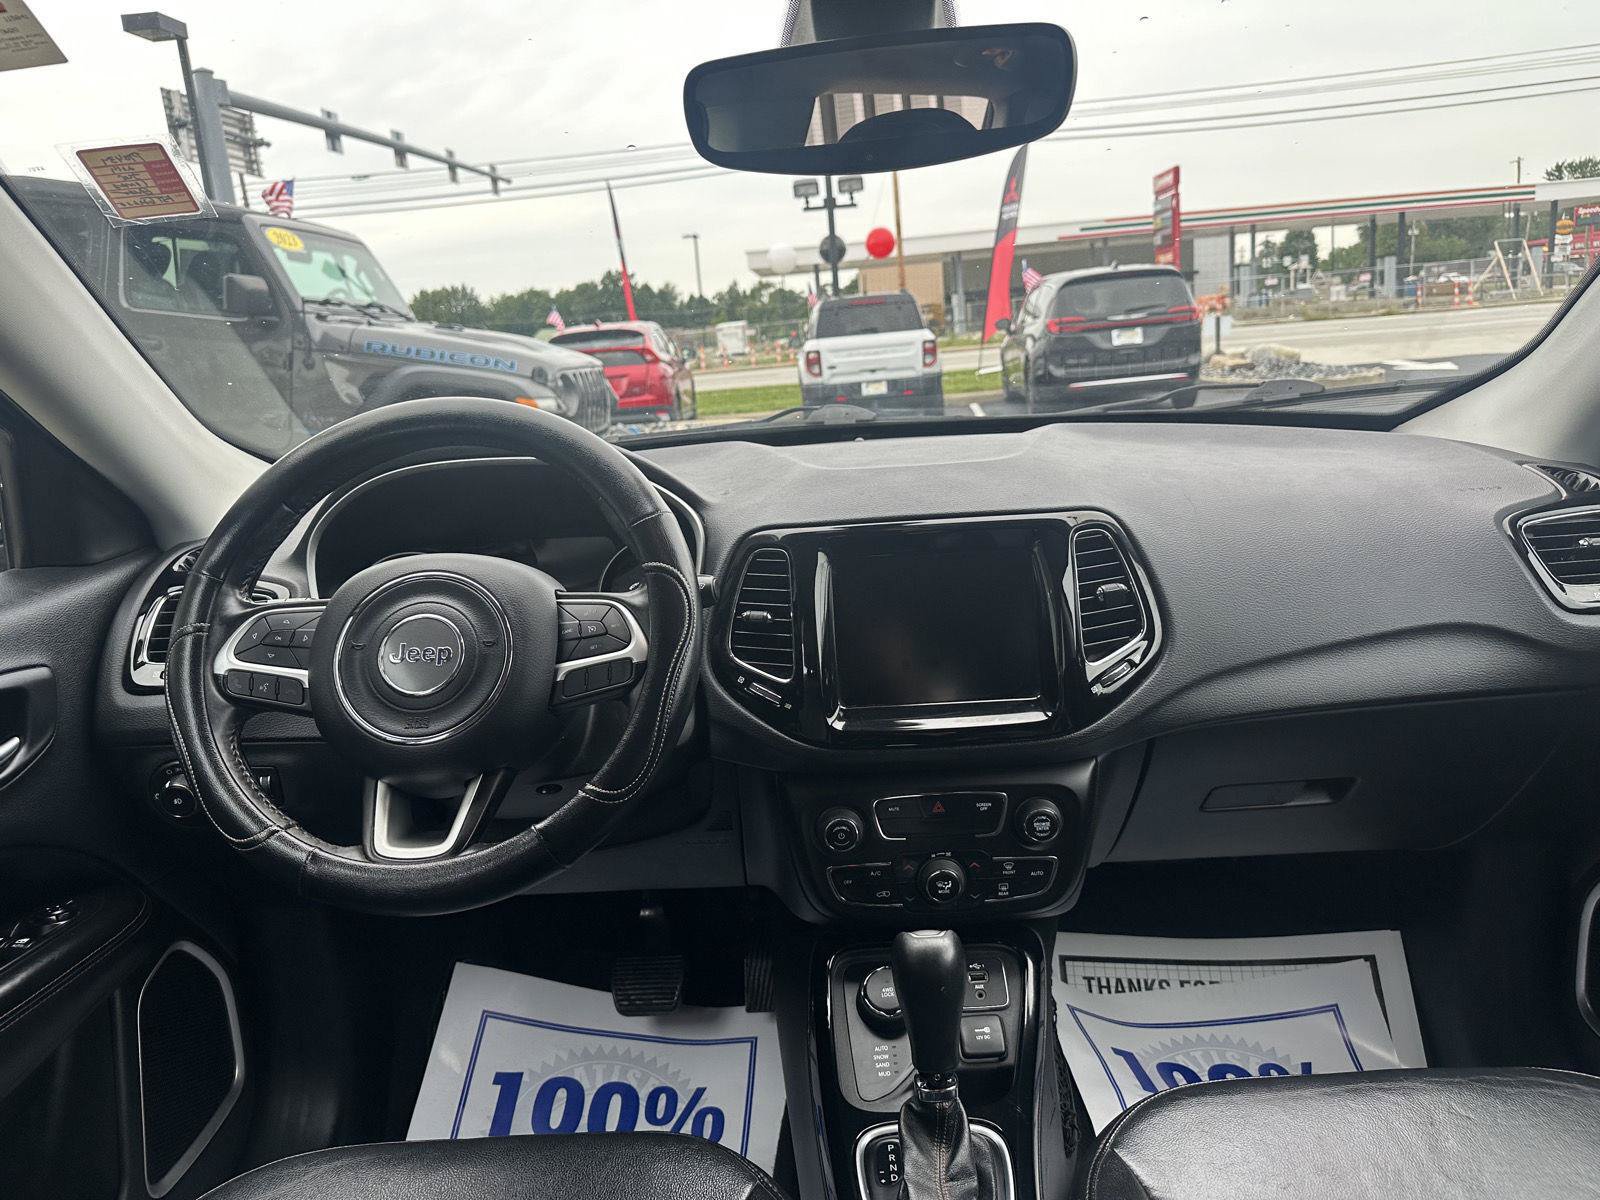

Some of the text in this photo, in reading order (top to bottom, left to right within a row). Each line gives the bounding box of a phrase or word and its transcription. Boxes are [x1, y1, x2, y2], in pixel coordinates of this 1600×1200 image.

[364, 339, 518, 373] RUBICON
[389, 642, 453, 667] Jeep
[878, 1070, 891, 1078] MUD
[488, 1071, 726, 1144] 100%
[889, 1163, 898, 1171] N
[890, 1173, 898, 1181] D
